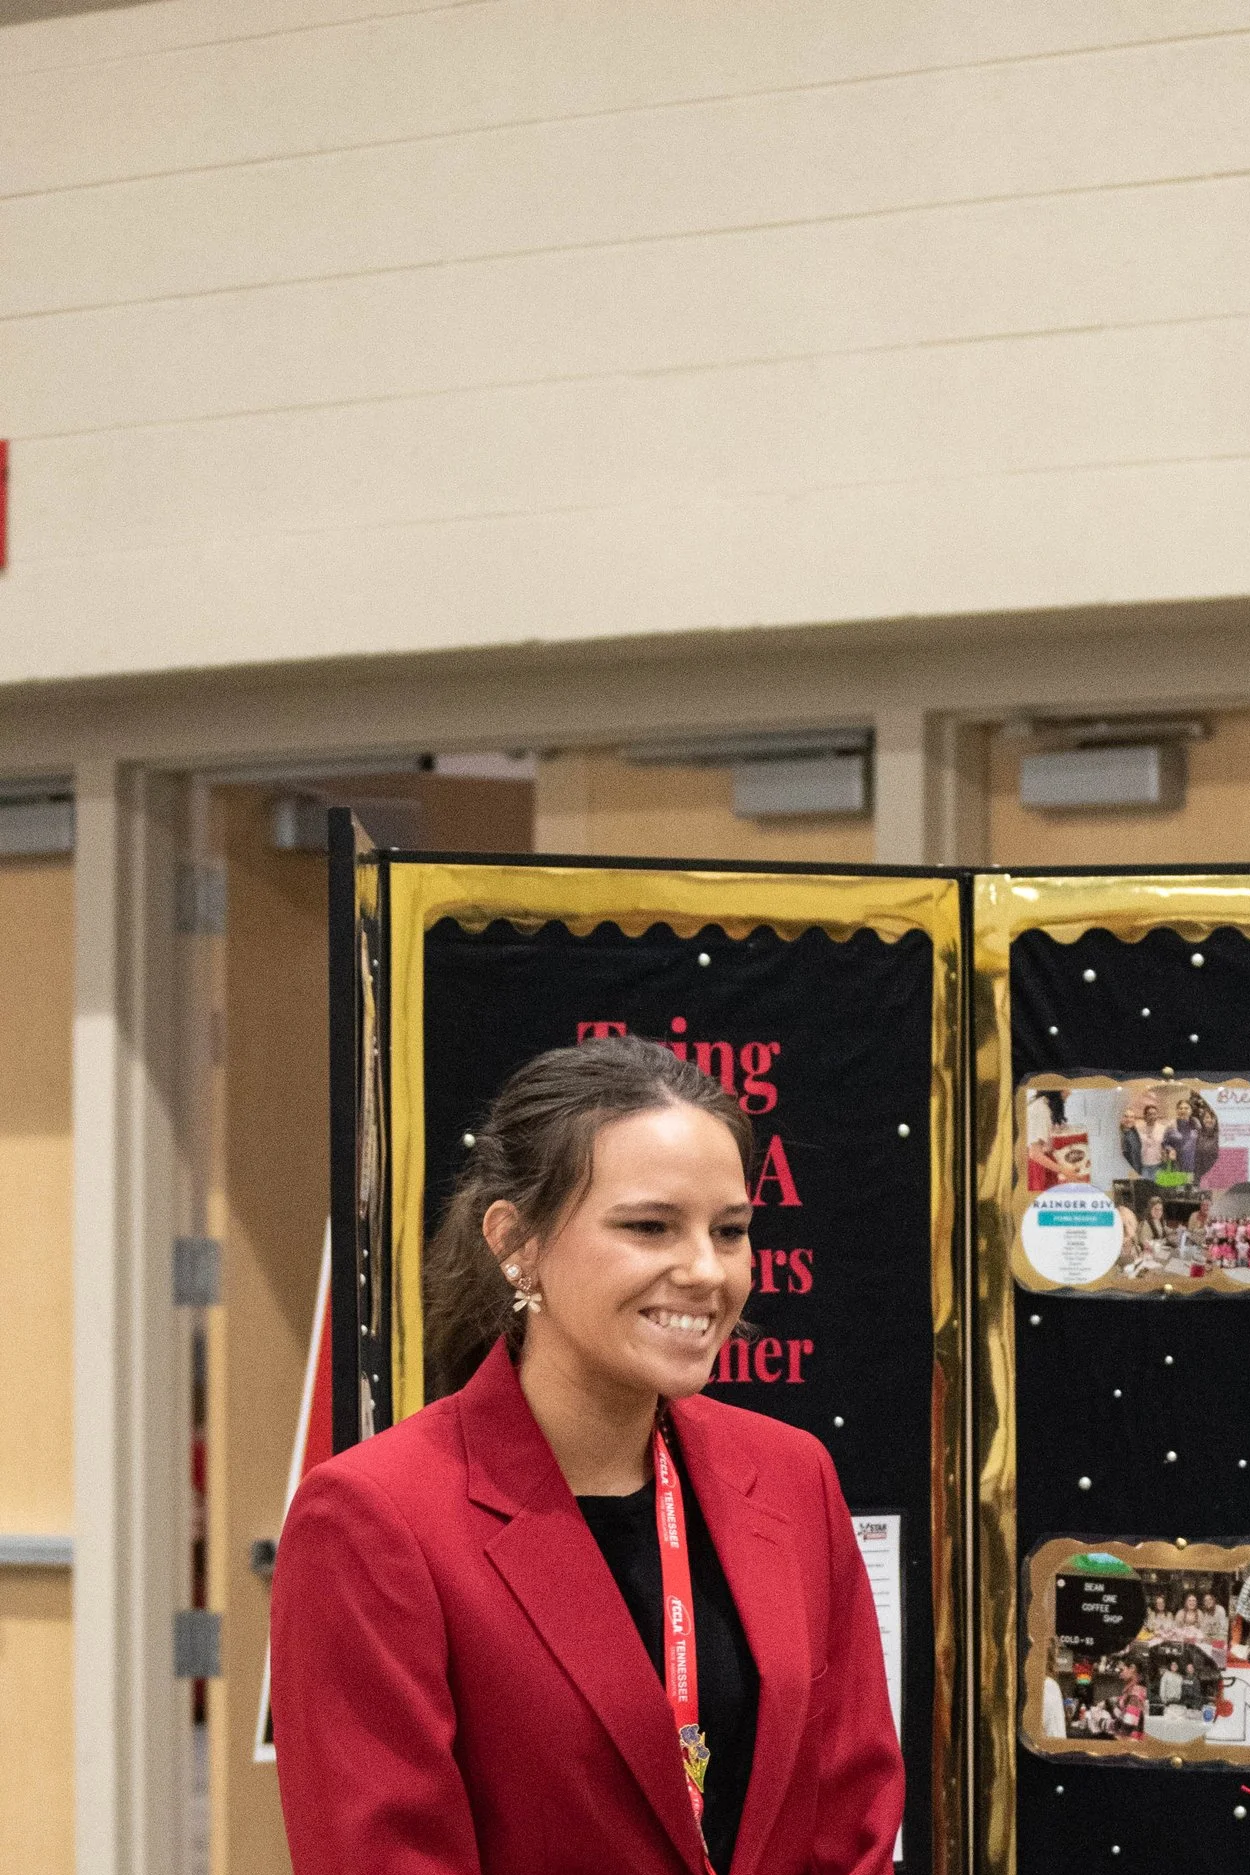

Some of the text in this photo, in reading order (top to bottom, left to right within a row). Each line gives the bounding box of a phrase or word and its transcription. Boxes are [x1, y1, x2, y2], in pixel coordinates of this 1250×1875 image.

[664, 1491, 680, 1549] TENNESSEE
[671, 1599, 683, 1633] FCCLA
[1081, 1603, 1110, 1613] COFFEE
[1103, 1614, 1123, 1624] SHOP
[676, 1640, 688, 1702] TENNESSEE
